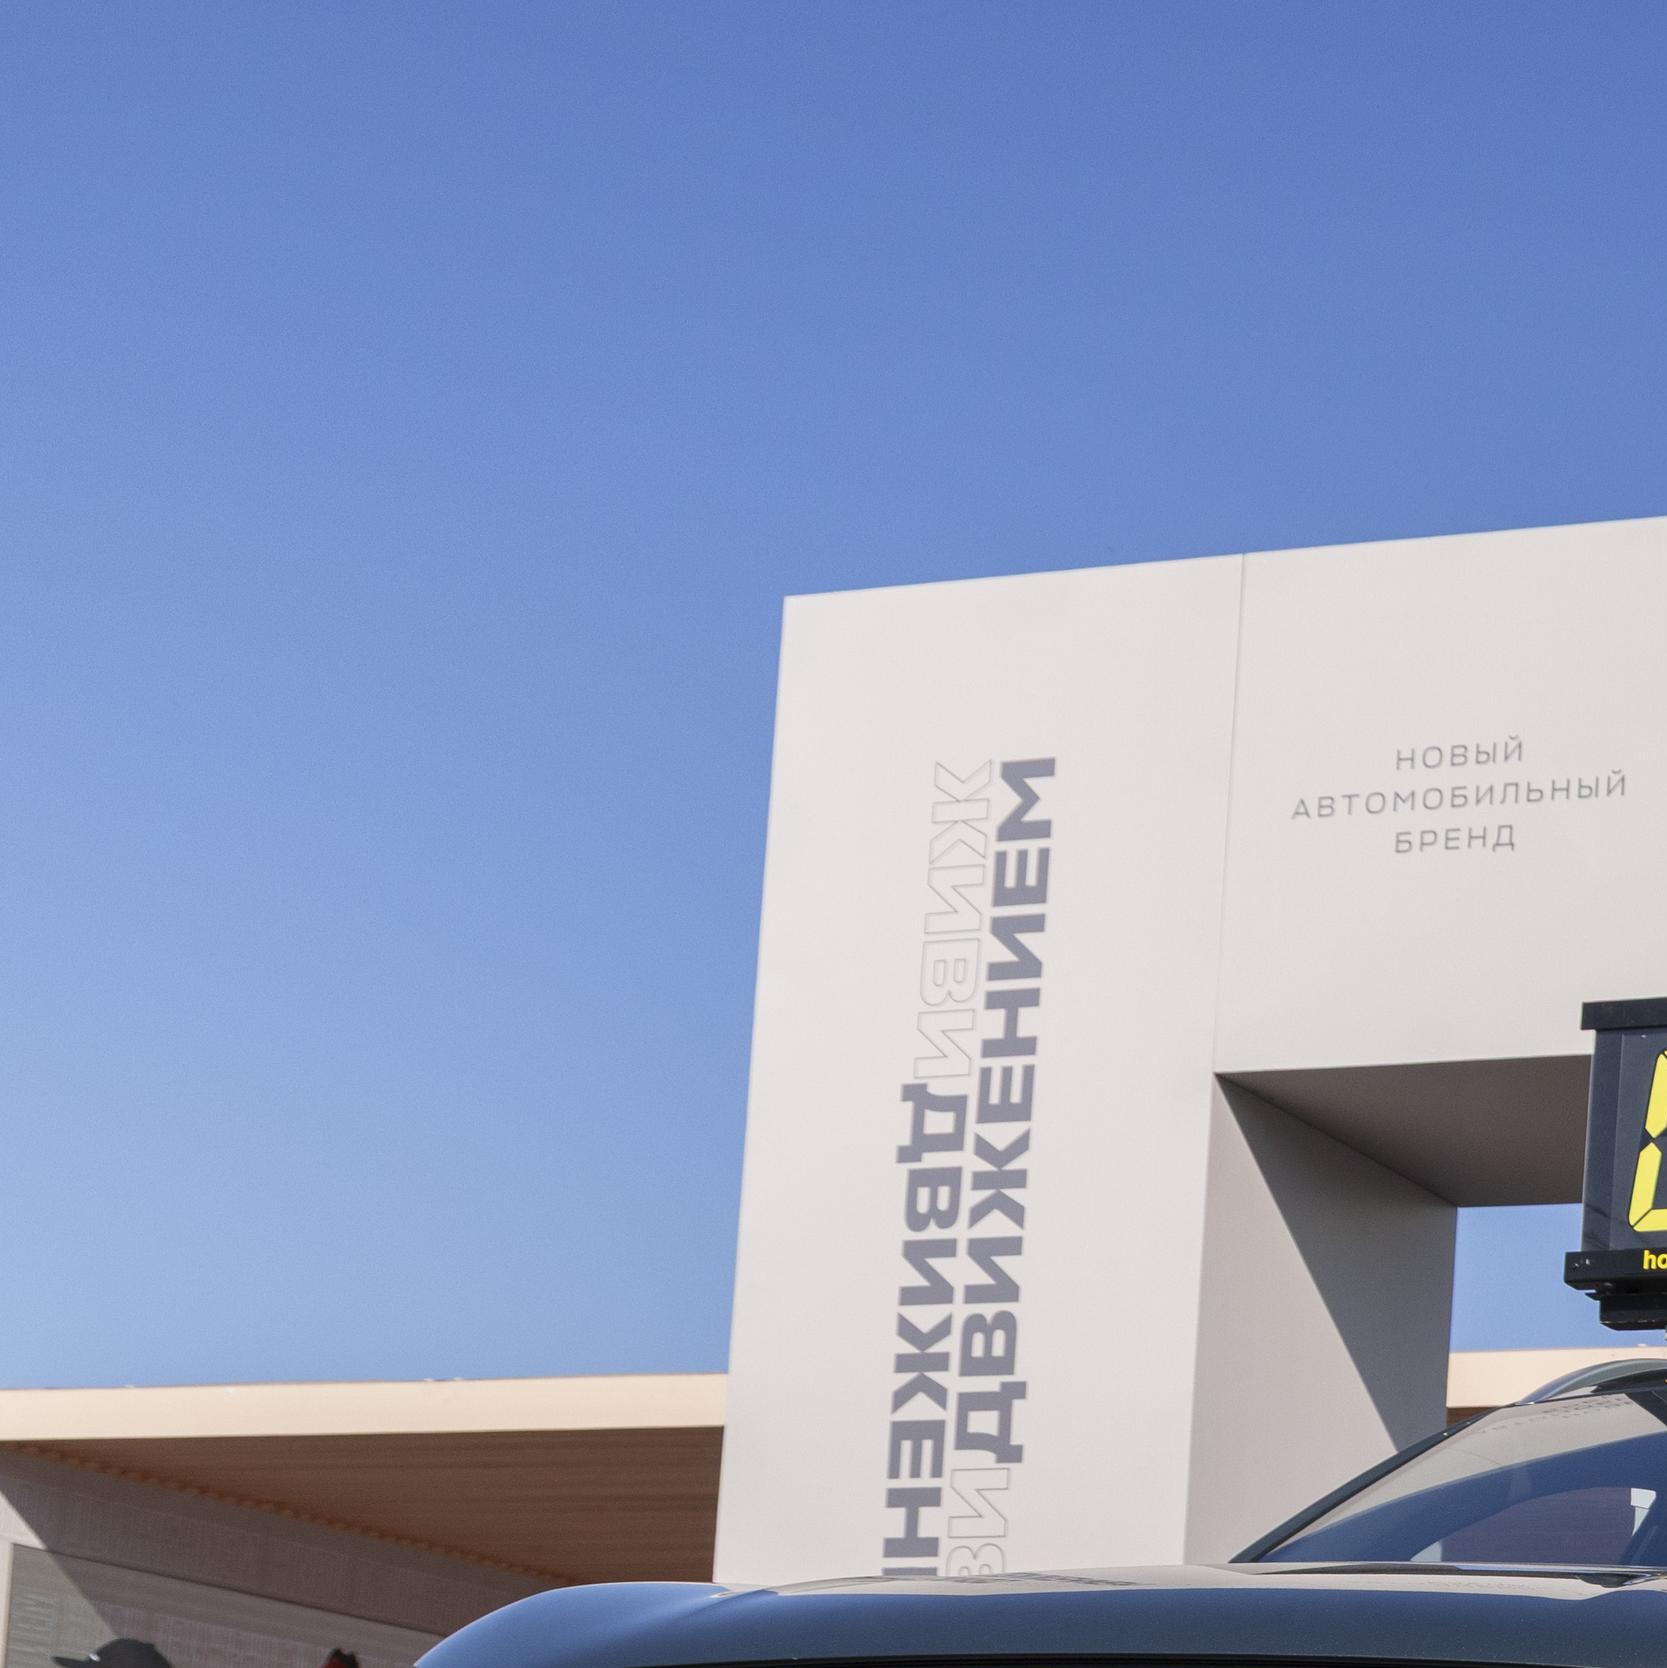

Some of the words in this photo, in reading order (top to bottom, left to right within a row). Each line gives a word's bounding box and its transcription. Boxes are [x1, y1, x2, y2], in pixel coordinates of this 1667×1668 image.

[1395, 734, 1523, 771] НОВЫЙ
[1291, 768, 1627, 820] АВТОМОБИЛЬНЫЙ
[1394, 823, 1516, 854] БРЕНД
[953, 756, 1057, 1464] ДВИЖЕНИЕМ
[881, 1082, 968, 1576] ДВИЖЕН
